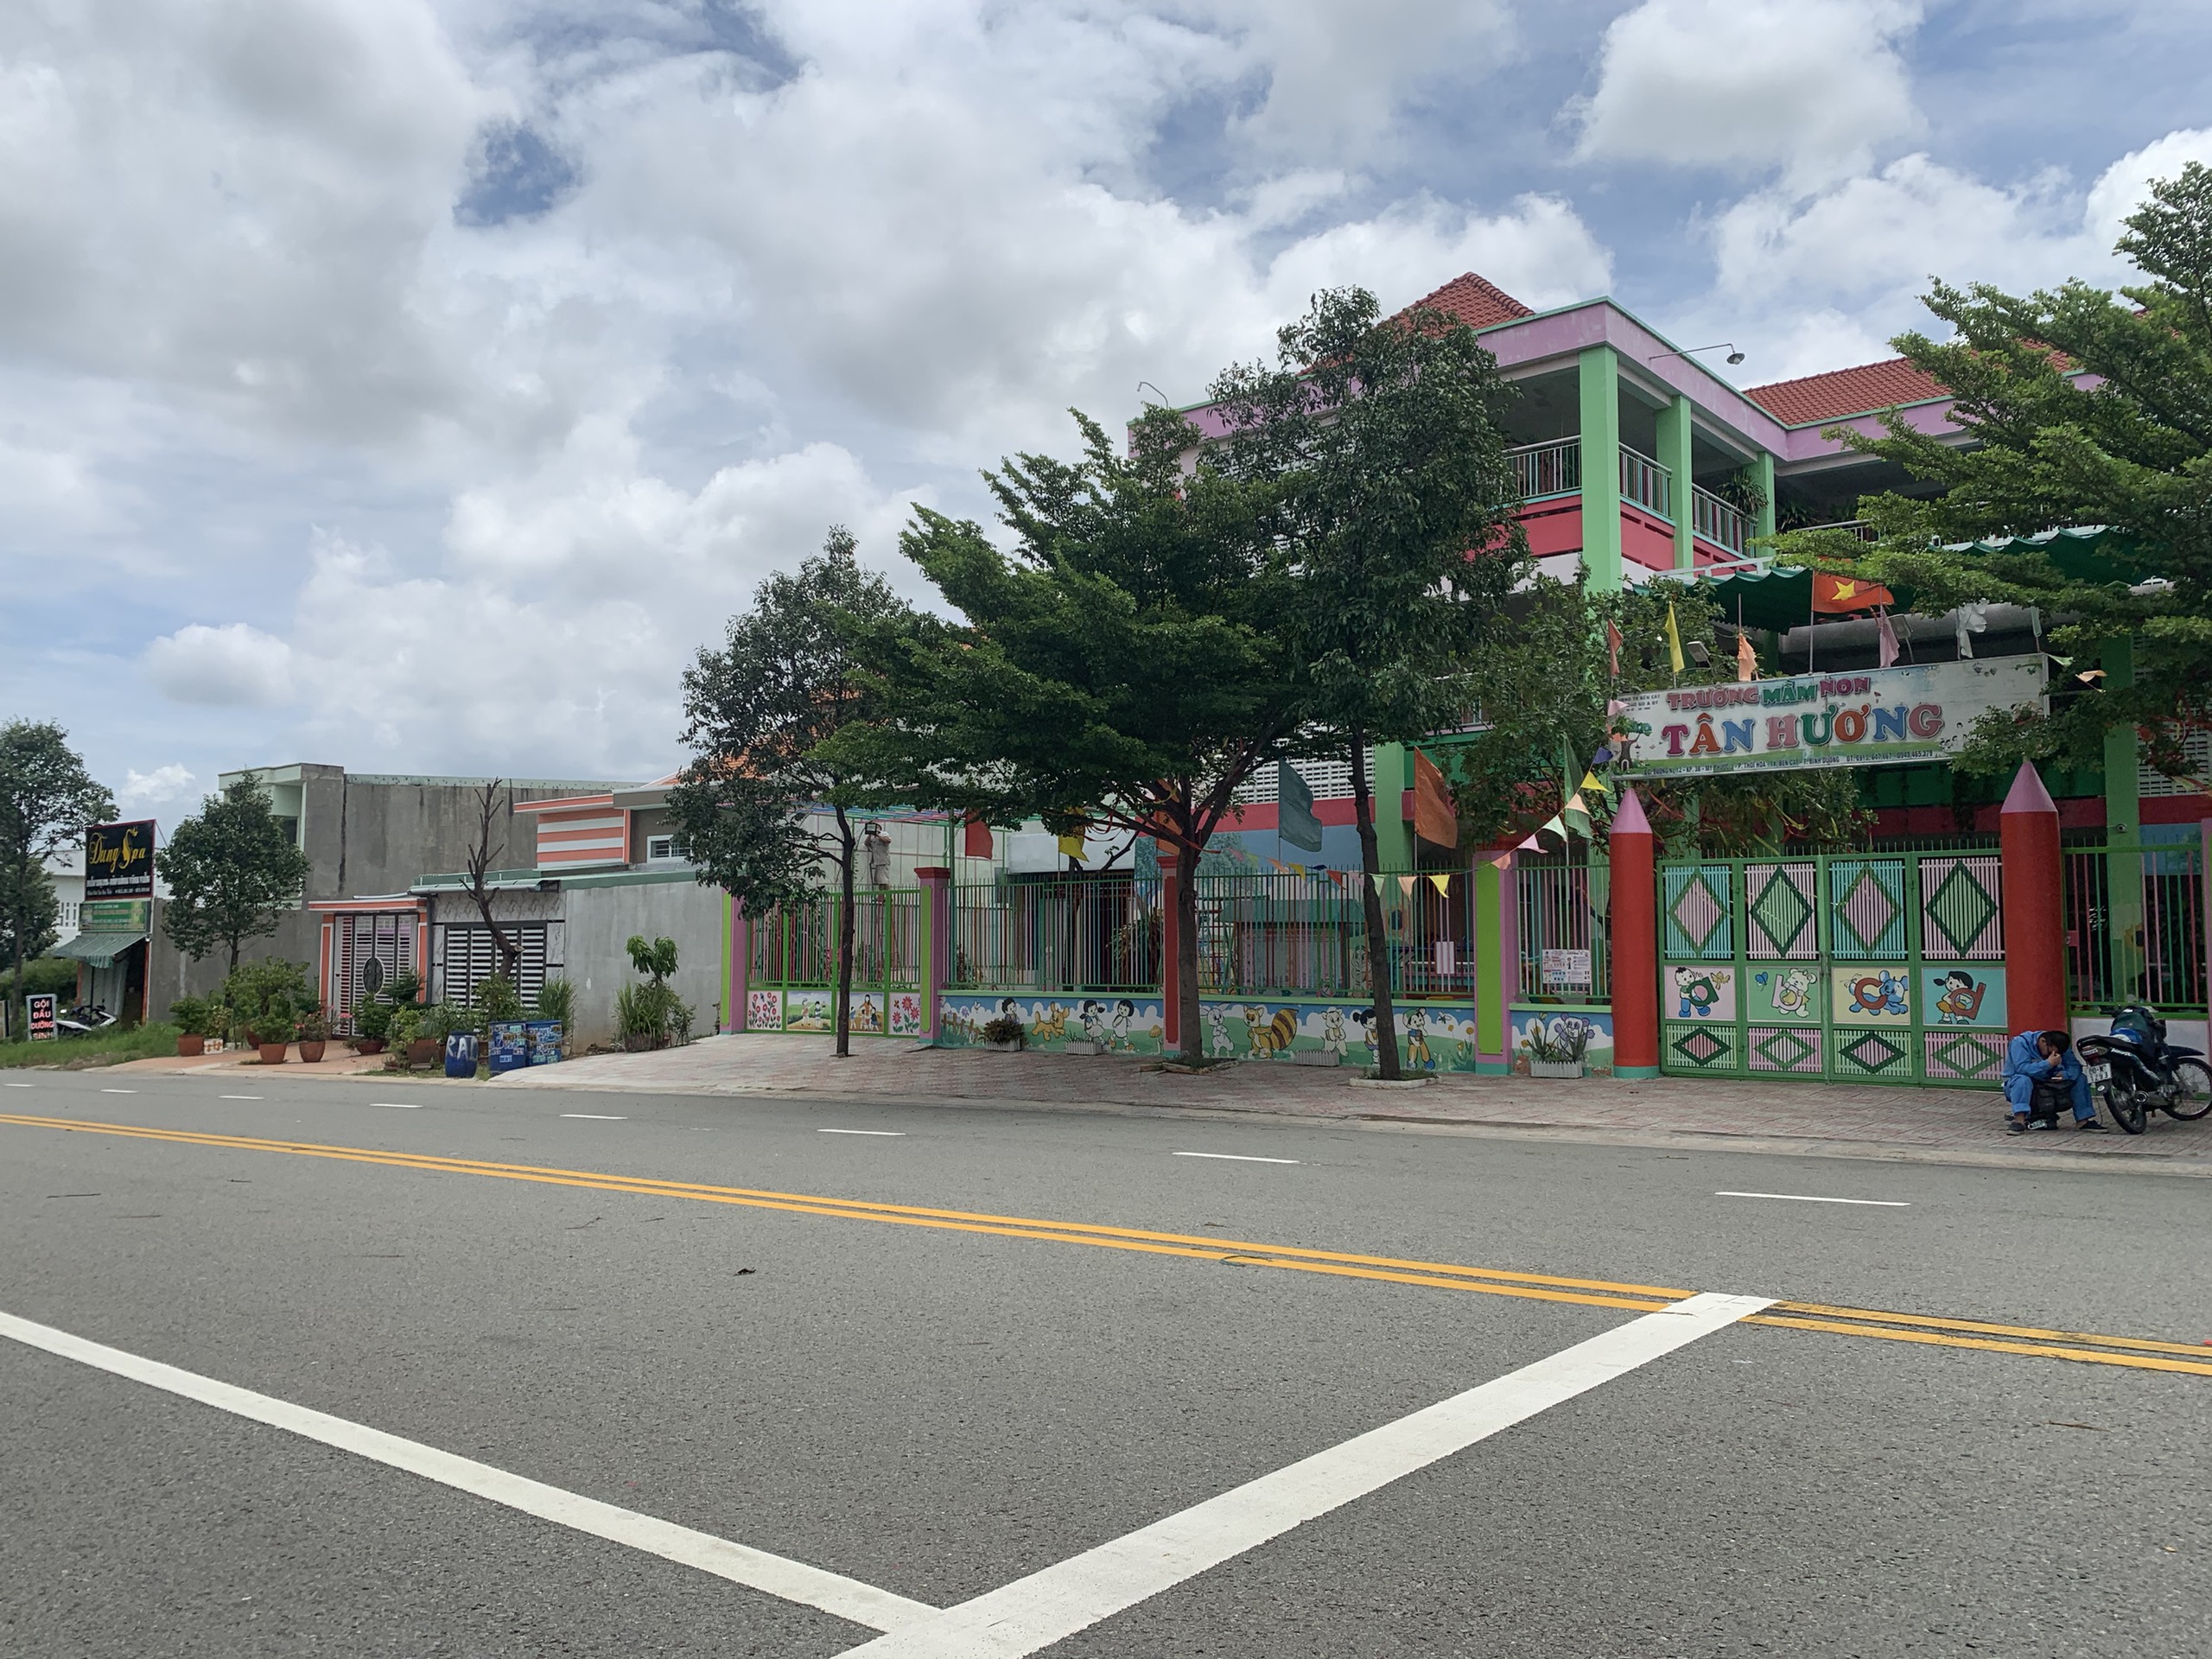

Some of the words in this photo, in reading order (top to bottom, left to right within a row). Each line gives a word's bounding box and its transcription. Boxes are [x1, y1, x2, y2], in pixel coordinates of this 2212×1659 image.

[1820, 676, 1872, 697] NON
[1662, 712, 1755, 756] TÂN
[1765, 702, 1945, 750] HƯƠNG
[1771, 973, 1804, 1011] b
